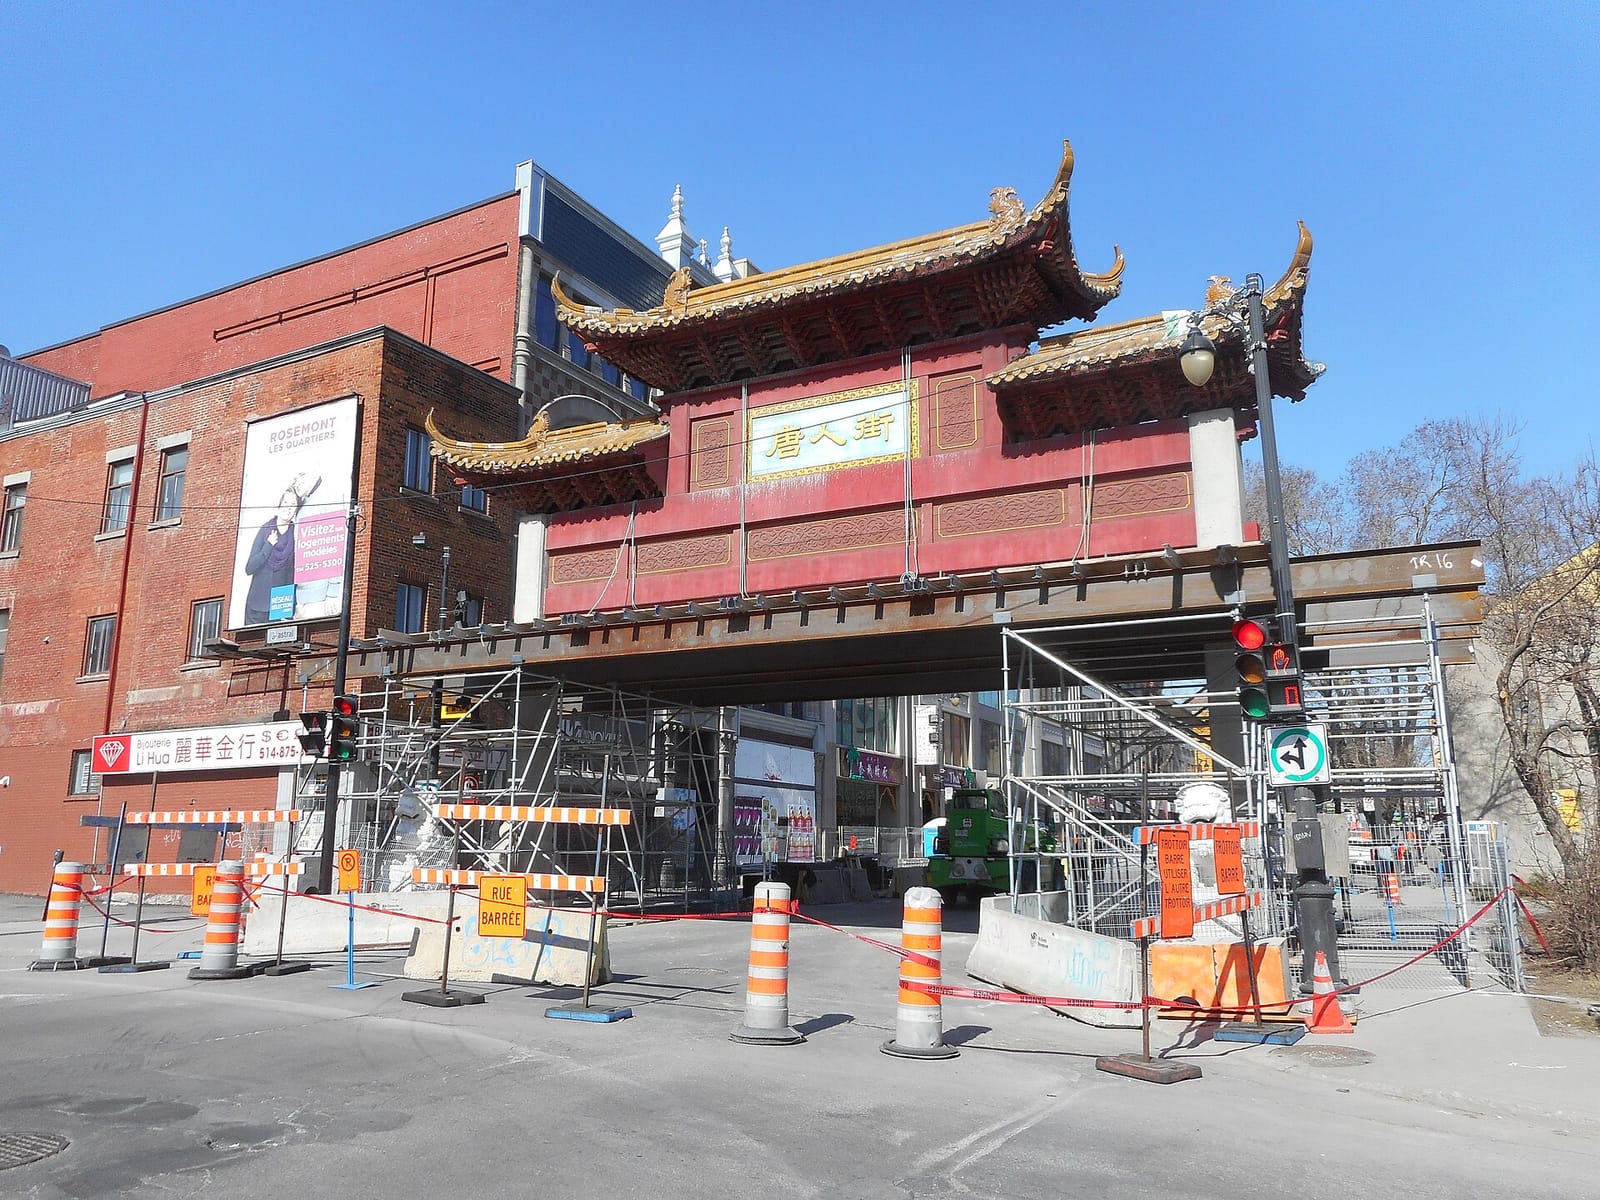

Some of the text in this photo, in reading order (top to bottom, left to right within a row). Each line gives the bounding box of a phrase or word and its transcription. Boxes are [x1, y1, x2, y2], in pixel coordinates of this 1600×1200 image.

[270, 416, 337, 443] ROSEMONT
[766, 411, 895, 460] 唐人街
[269, 443, 284, 454] LES
[286, 430, 336, 449] QUARTIERS
[301, 524, 335, 538] Visitez
[298, 534, 345, 550] logements
[305, 558, 343, 570] 525-5300
[1436, 553, 1453, 569] 16
[136, 738, 172, 751] Bijouterie
[174, 733, 256, 764] 麗華金行
[136, 751, 170, 765] Li Hua
[1161, 839, 1188, 850] TROTTOIR
[1215, 840, 1240, 855] TROTTOIR
[1164, 868, 1188, 879] UTILISER
[492, 886, 513, 901] RUE
[1165, 897, 1191, 909] TROTTOIR
[481, 910, 521, 926] BARRÉE
